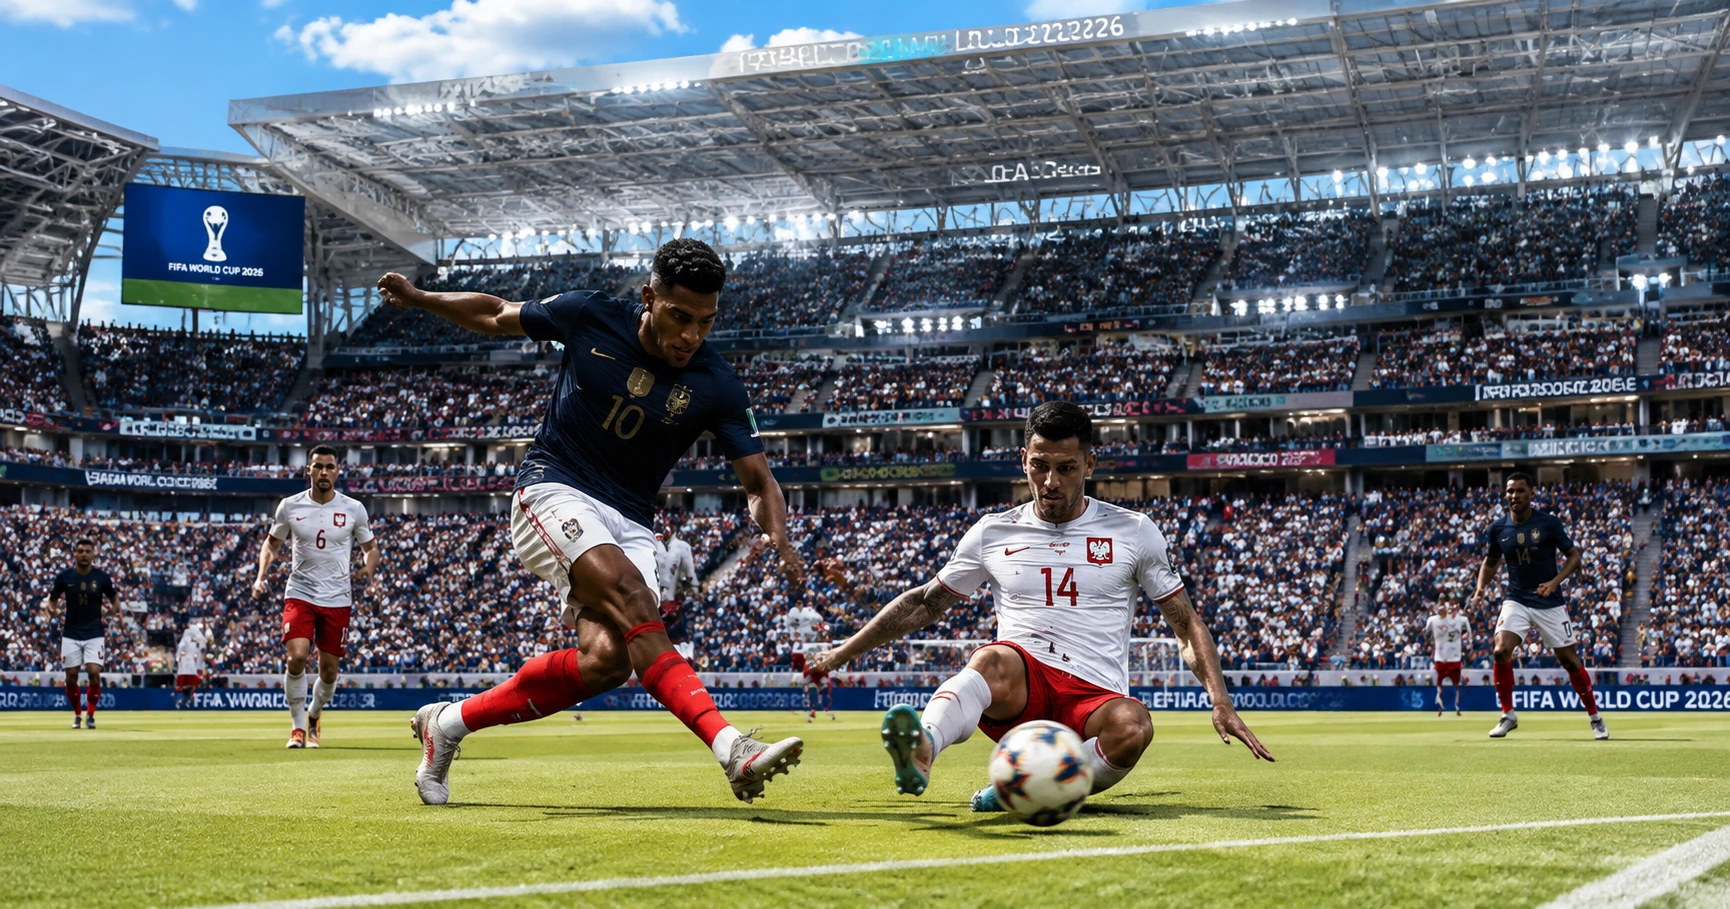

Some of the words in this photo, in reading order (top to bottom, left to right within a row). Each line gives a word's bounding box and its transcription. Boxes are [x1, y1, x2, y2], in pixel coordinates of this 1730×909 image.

[168, 262, 188, 272] FIFA
[189, 263, 221, 275] WORLD
[222, 265, 241, 275] CUP
[602, 394, 645, 440] 10
[316, 529, 326, 550] 6
[1516, 547, 1531, 565] 14
[1041, 567, 1079, 606] 14
[1512, 690, 1555, 709] FIFA
[1636, 690, 1679, 709] CUP
